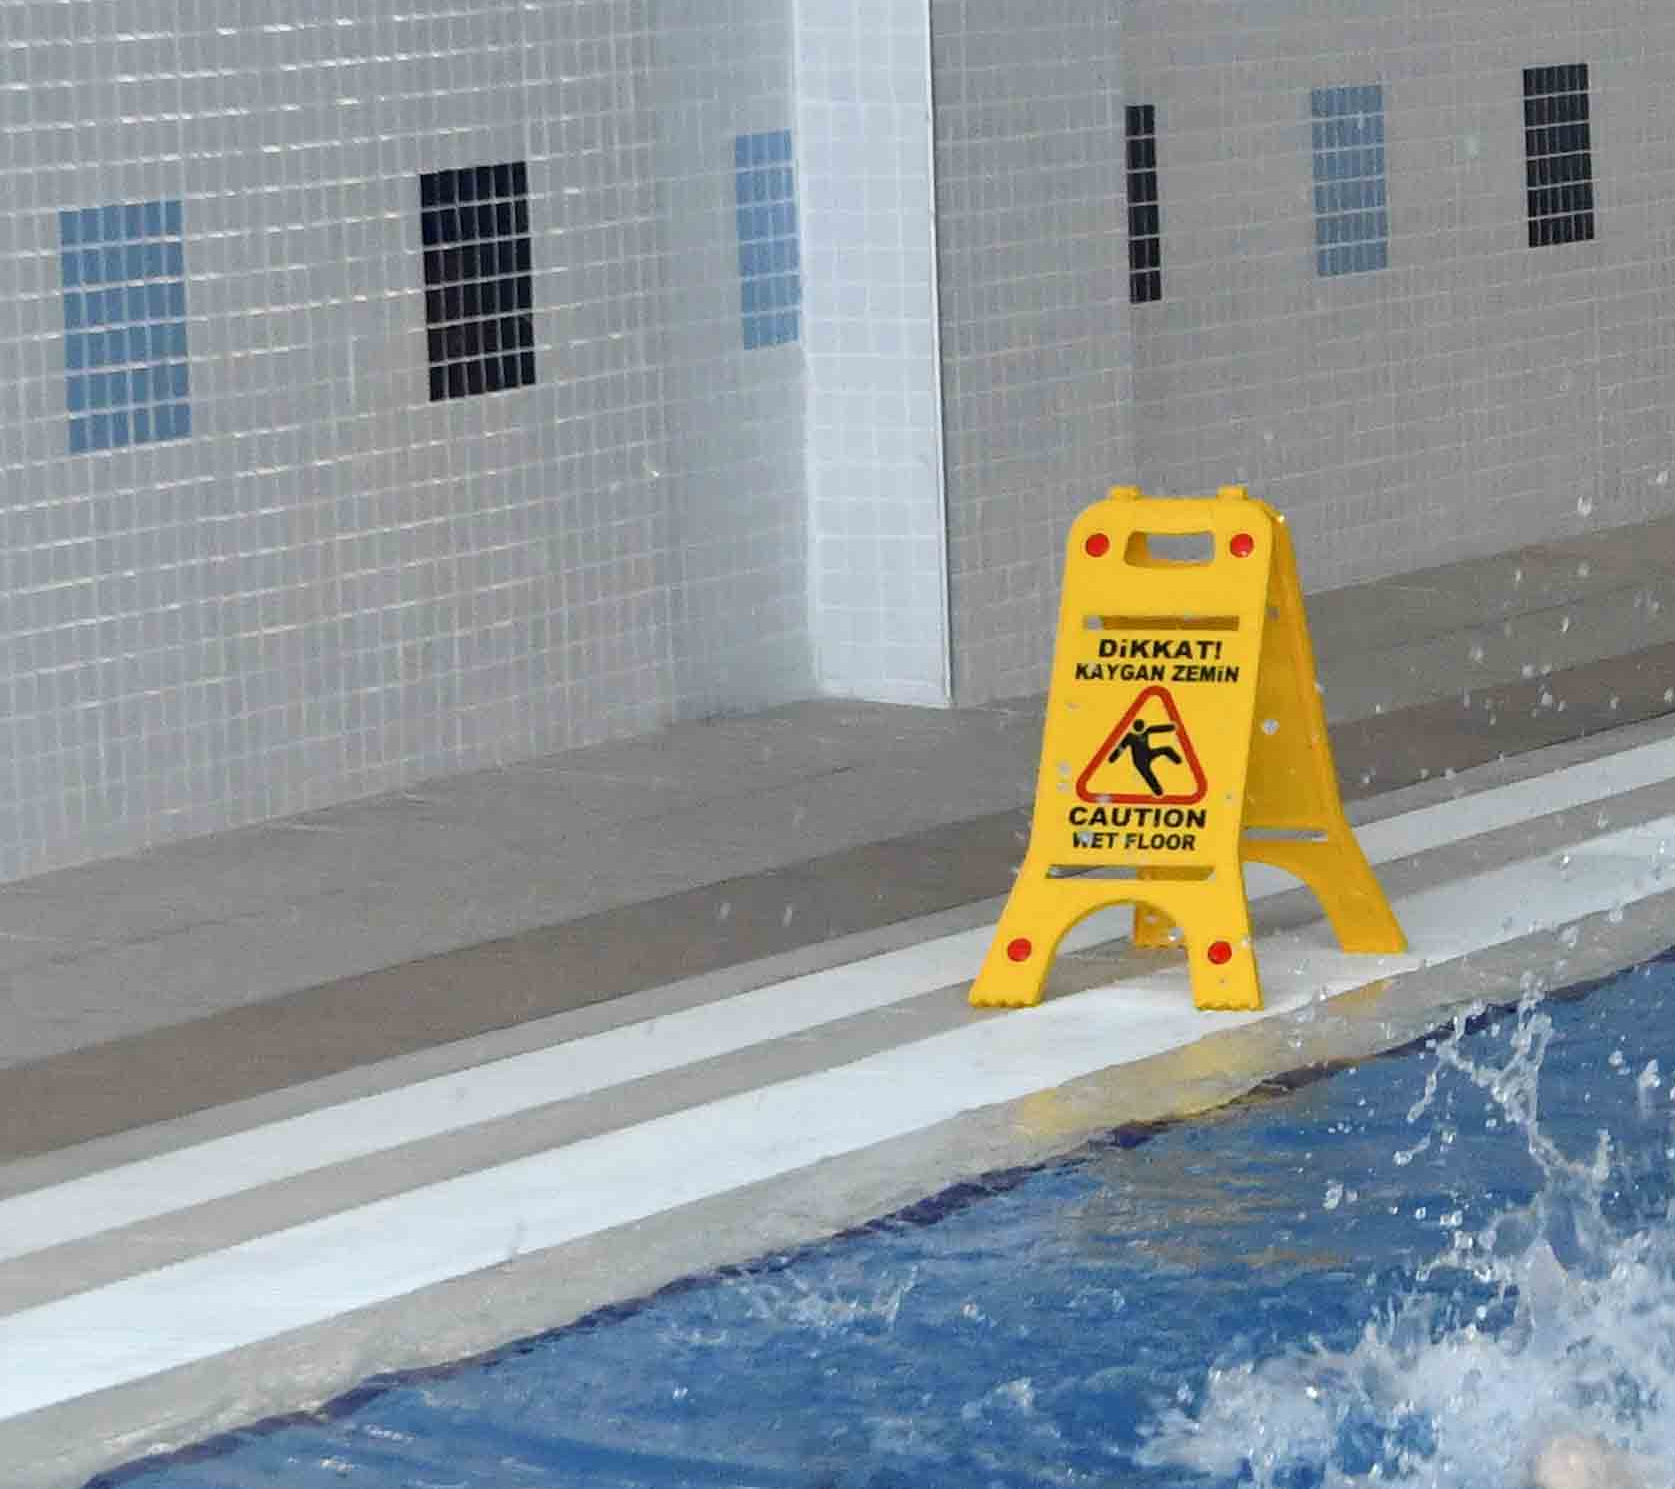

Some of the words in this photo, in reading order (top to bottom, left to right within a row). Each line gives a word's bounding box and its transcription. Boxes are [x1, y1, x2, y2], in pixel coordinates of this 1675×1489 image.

[1075, 663, 1165, 682] KAYGAN
[1068, 806, 1207, 828] CAUTION
[1072, 832, 1118, 850] WET
[1125, 833, 1197, 851] FLOOR
